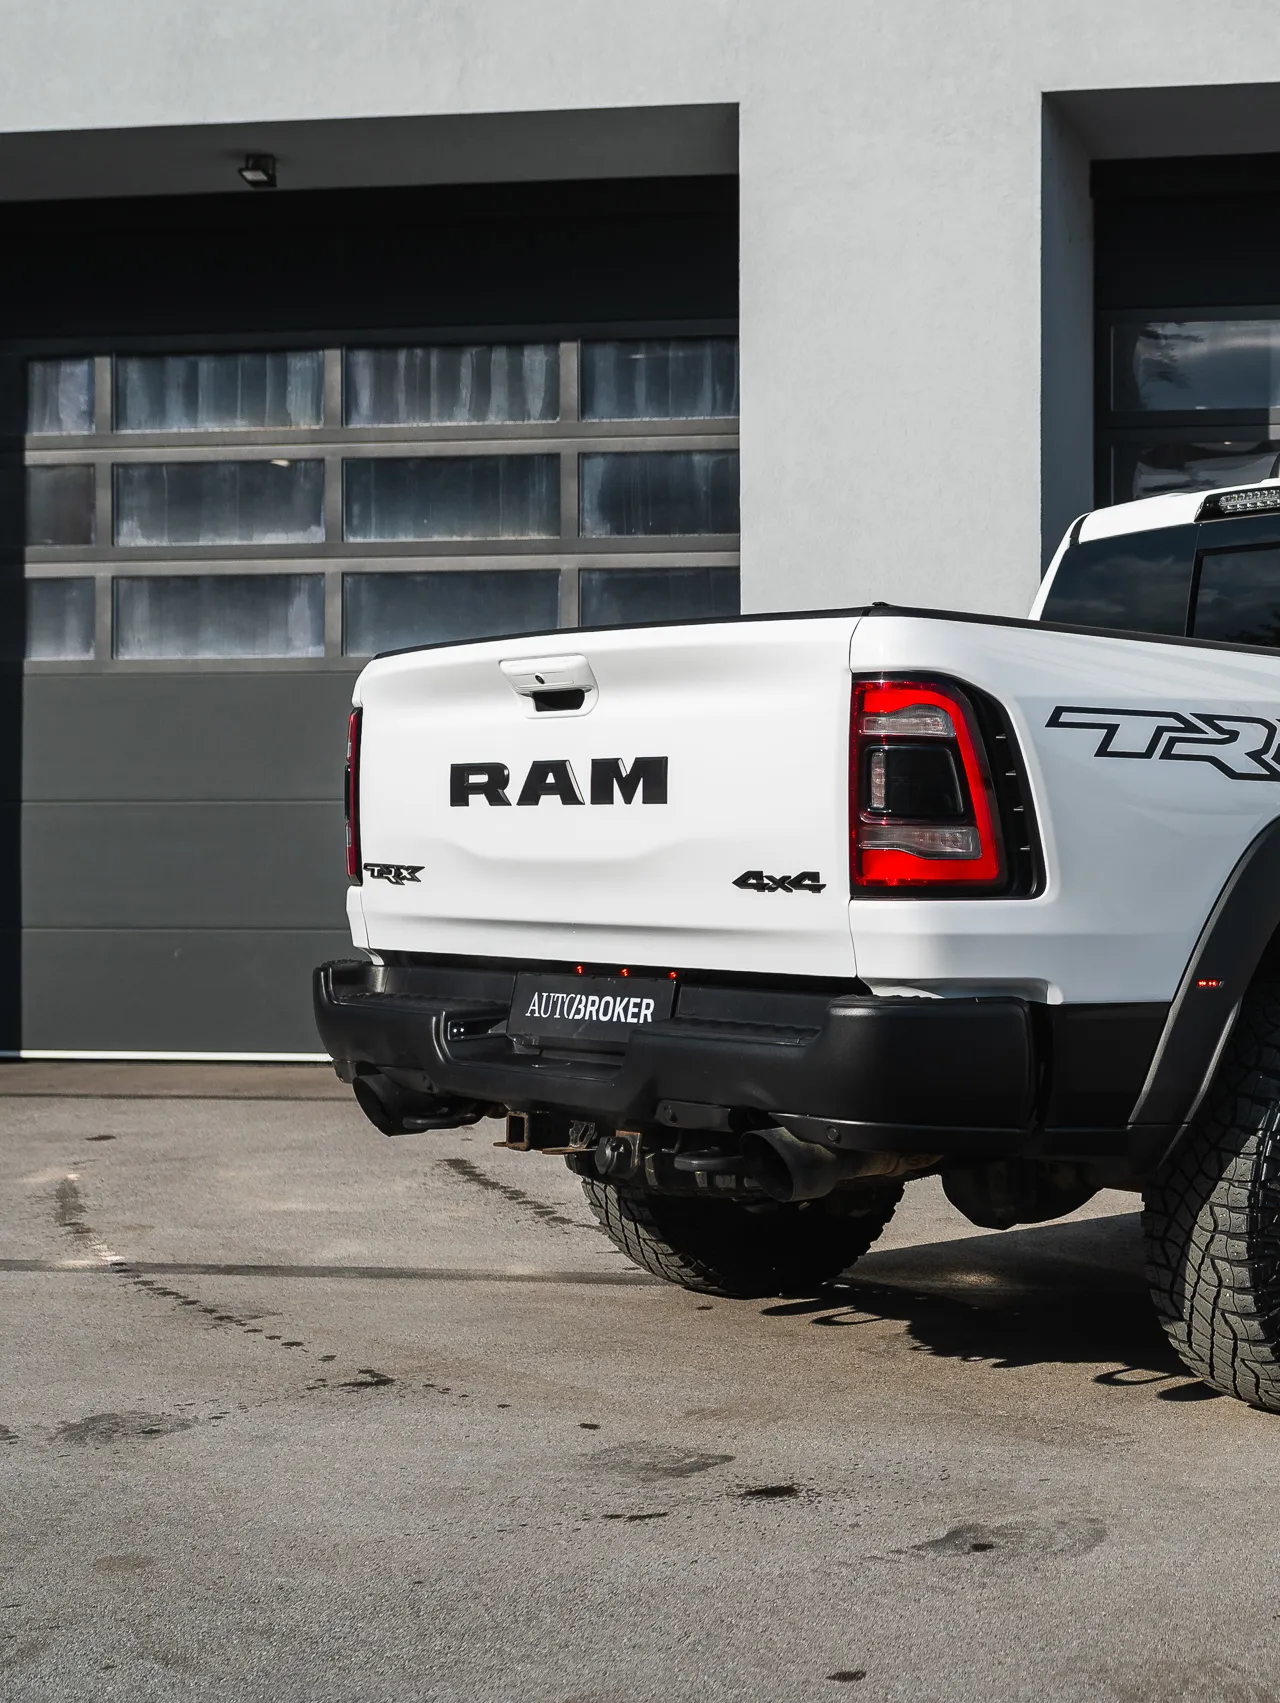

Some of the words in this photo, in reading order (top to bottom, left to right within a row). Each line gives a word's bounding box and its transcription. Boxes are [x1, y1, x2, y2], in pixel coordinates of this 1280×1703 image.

[450, 756, 669, 808] RAM
[363, 862, 426, 886] TRX
[731, 870, 827, 894] 4x4
[525, 991, 655, 1024] AUTOBROKER
